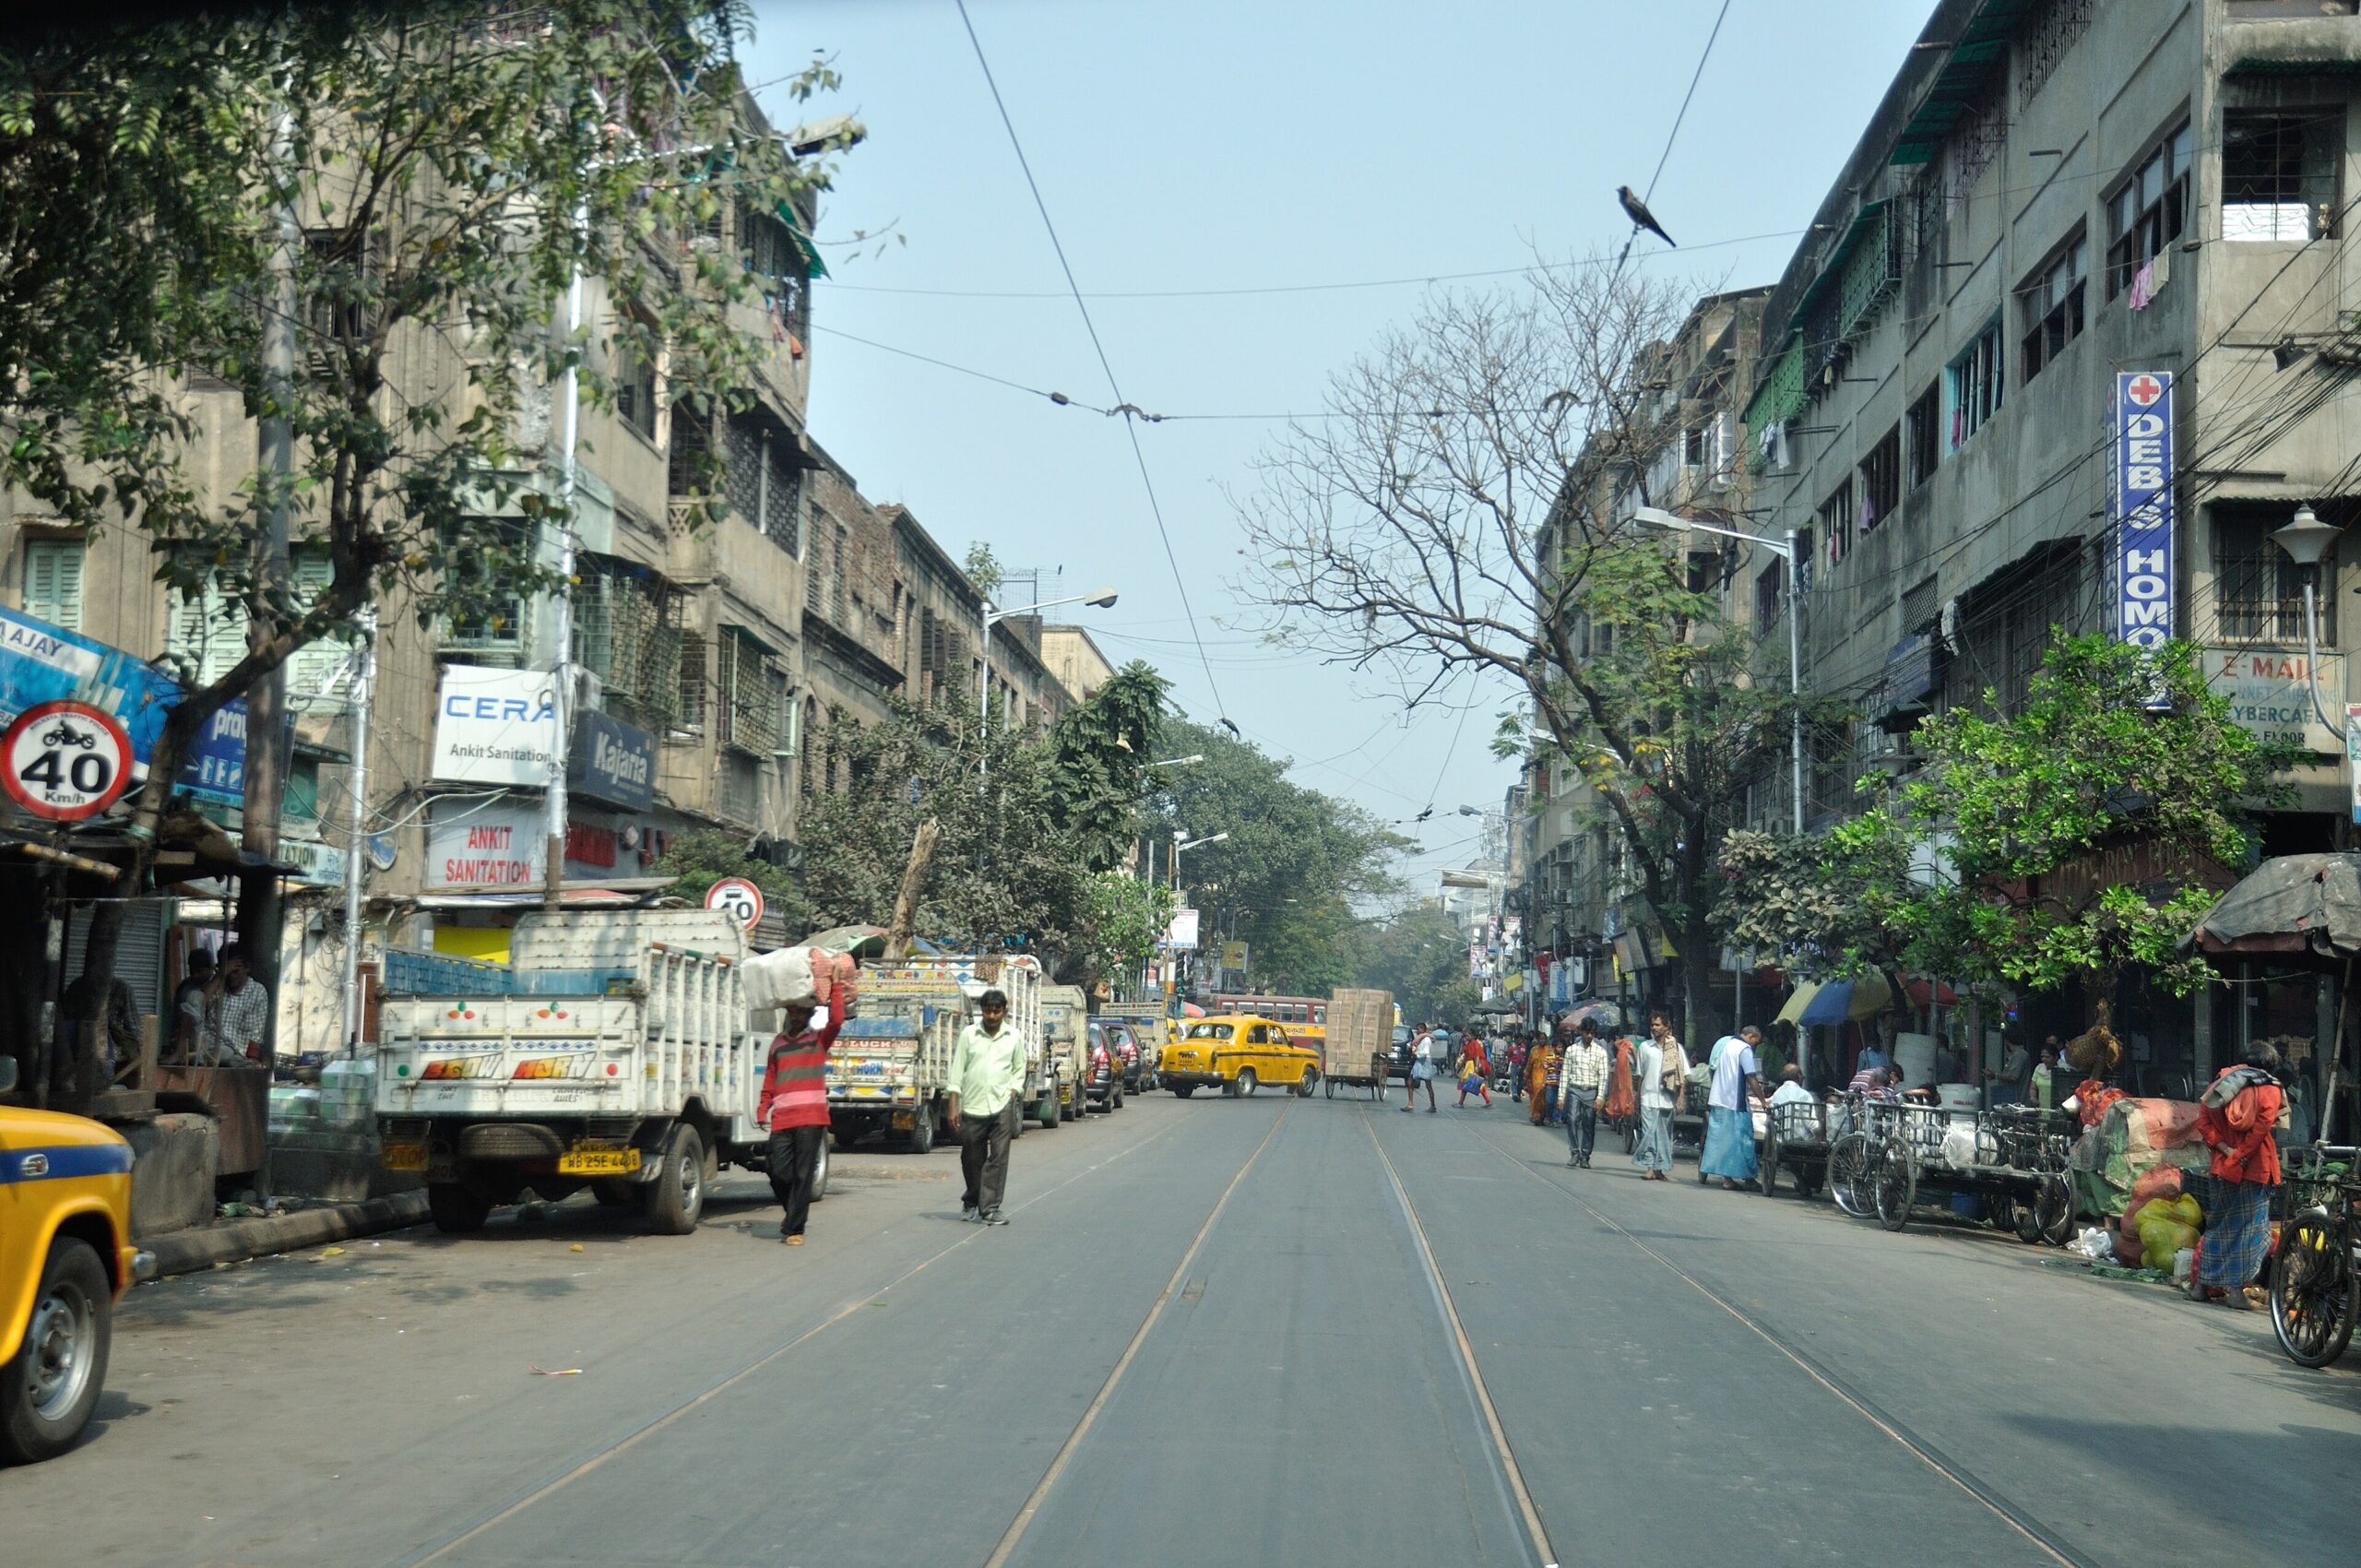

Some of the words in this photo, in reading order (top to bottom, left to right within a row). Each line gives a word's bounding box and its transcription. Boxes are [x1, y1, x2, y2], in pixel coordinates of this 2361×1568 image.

[10, 628, 63, 657] AJAY
[446, 695, 555, 722] CERA
[450, 742, 484, 757] Ankit
[487, 745, 552, 763] Sanitation
[593, 731, 648, 784] Kajaria
[21, 750, 113, 794] 40
[44, 791, 86, 804] Km/h
[468, 826, 513, 849] ANKIT
[445, 858, 531, 883] SANITATION
